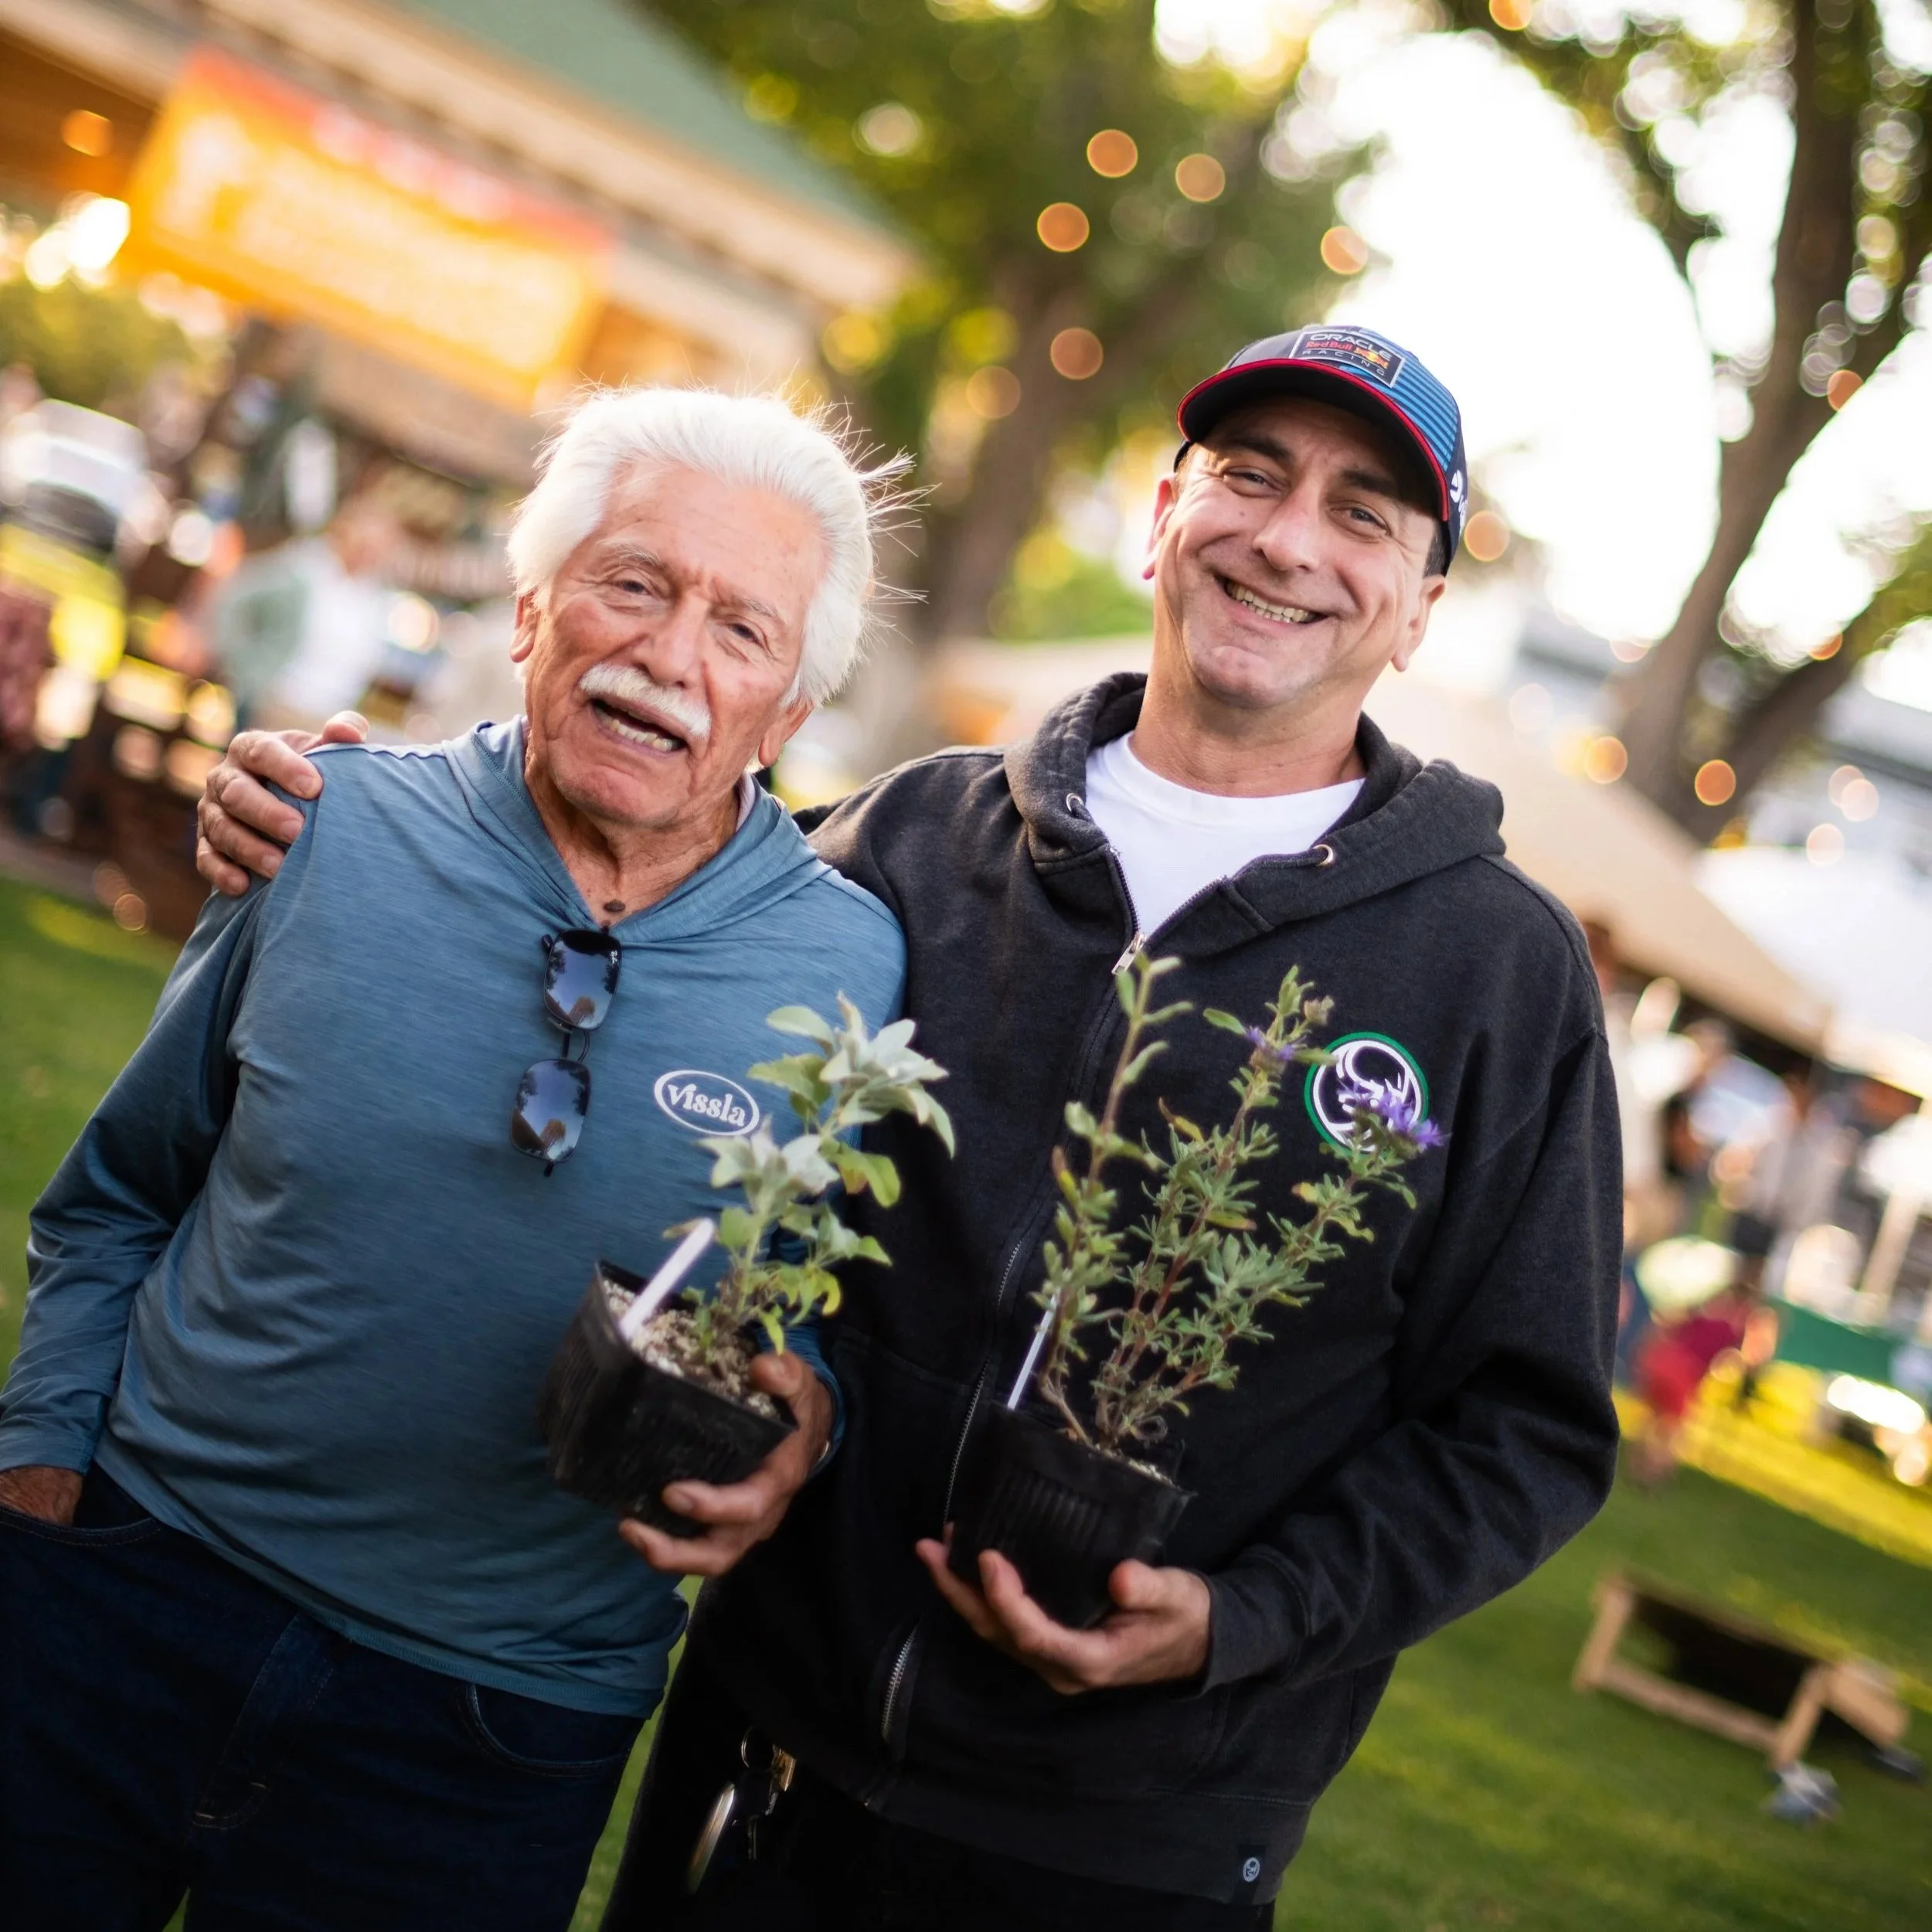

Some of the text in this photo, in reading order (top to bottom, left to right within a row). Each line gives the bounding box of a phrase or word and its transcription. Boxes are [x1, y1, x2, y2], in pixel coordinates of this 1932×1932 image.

[1306, 341, 1354, 352] Red Bull
[1310, 334, 1392, 362] ORACLE
[1302, 349, 1385, 376] RACING
